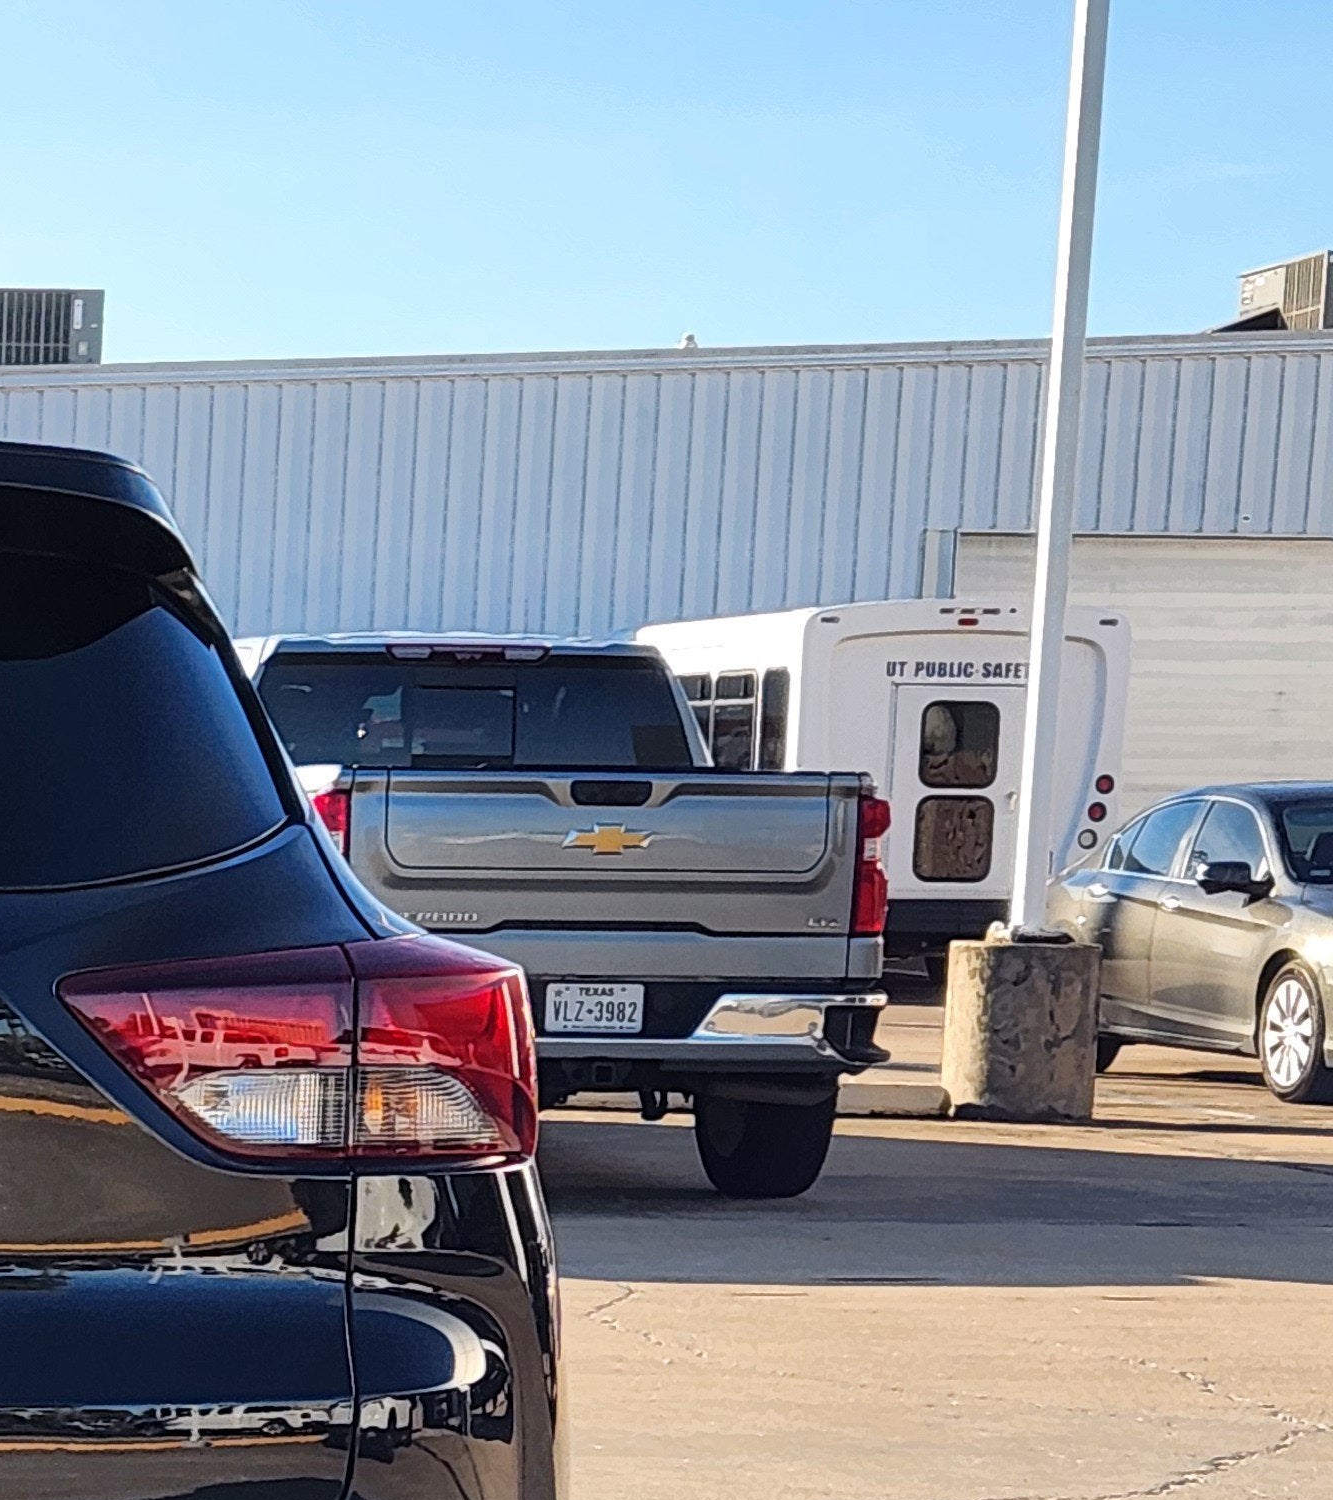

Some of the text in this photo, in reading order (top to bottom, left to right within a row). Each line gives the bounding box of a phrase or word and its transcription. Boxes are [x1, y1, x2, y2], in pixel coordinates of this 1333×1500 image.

[886, 661, 908, 677] UT
[914, 661, 974, 678] PUBLIC
[579, 987, 614, 997] TEXAS
